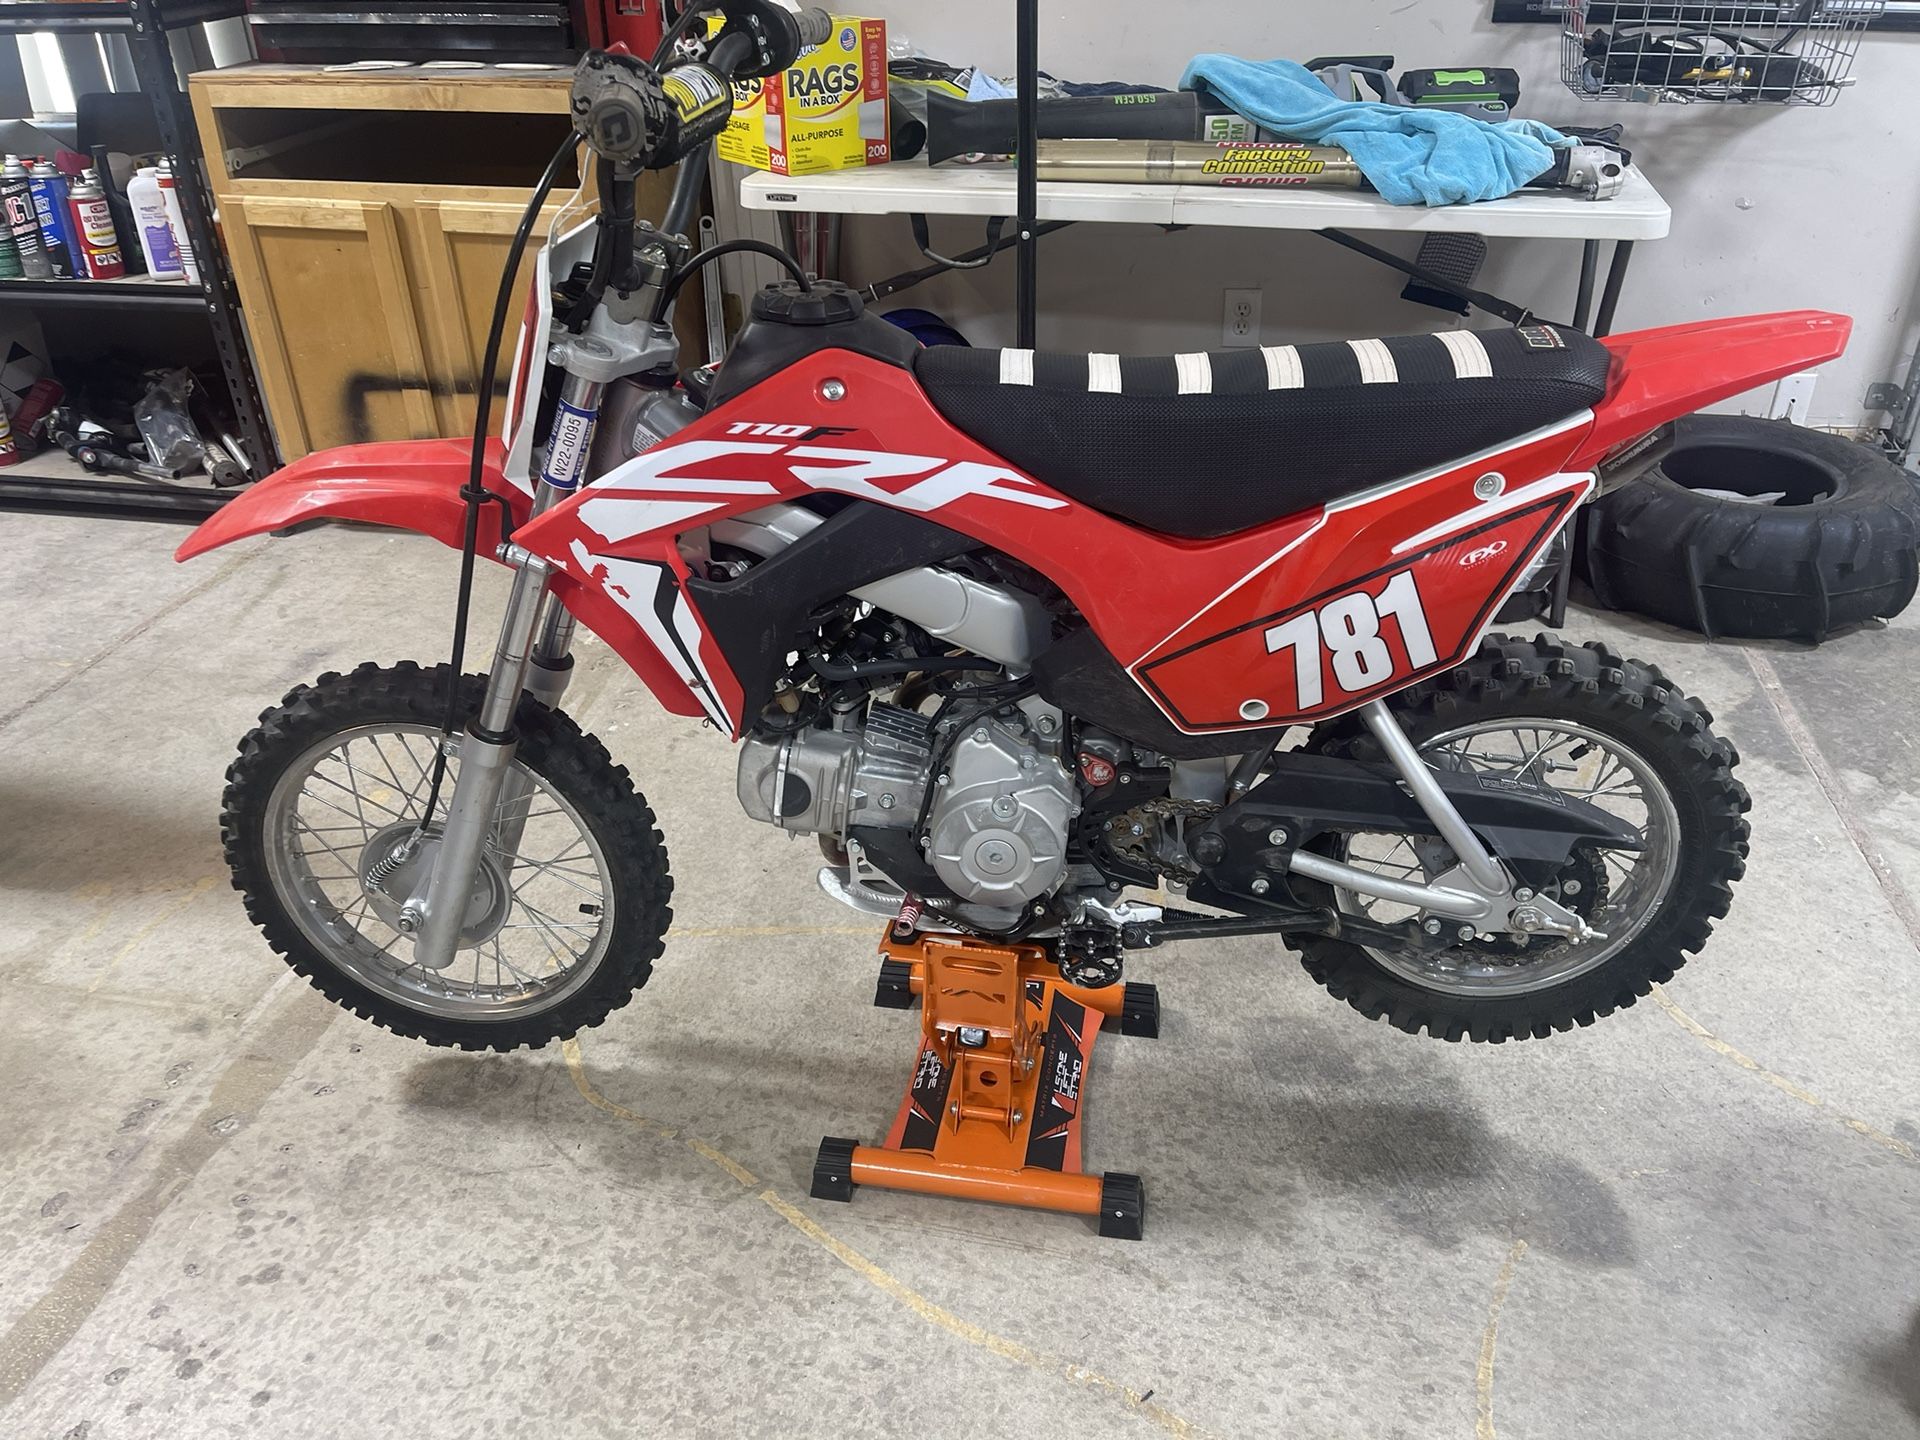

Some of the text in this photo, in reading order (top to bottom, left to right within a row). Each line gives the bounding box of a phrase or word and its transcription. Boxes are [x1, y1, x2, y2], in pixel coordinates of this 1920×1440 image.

[788, 64, 859, 98] RAGS
[735, 91, 749, 102] BOX
[800, 95, 842, 107] IN A BOX
[1114, 95, 1134, 104] CFM
[791, 128, 844, 142] ALL-PURPOSE
[1211, 118, 1229, 140] 50
[868, 145, 887, 158] 200
[1223, 149, 1311, 160] Factory
[771, 153, 786, 167] 200
[1202, 159, 1325, 174] Connection
[725, 421, 858, 441] 110F
[553, 418, 582, 477] W22-0095
[1606, 434, 1659, 472] YOSHIMURA
[586, 440, 1070, 513] CRF
[1264, 567, 1440, 711] 781
